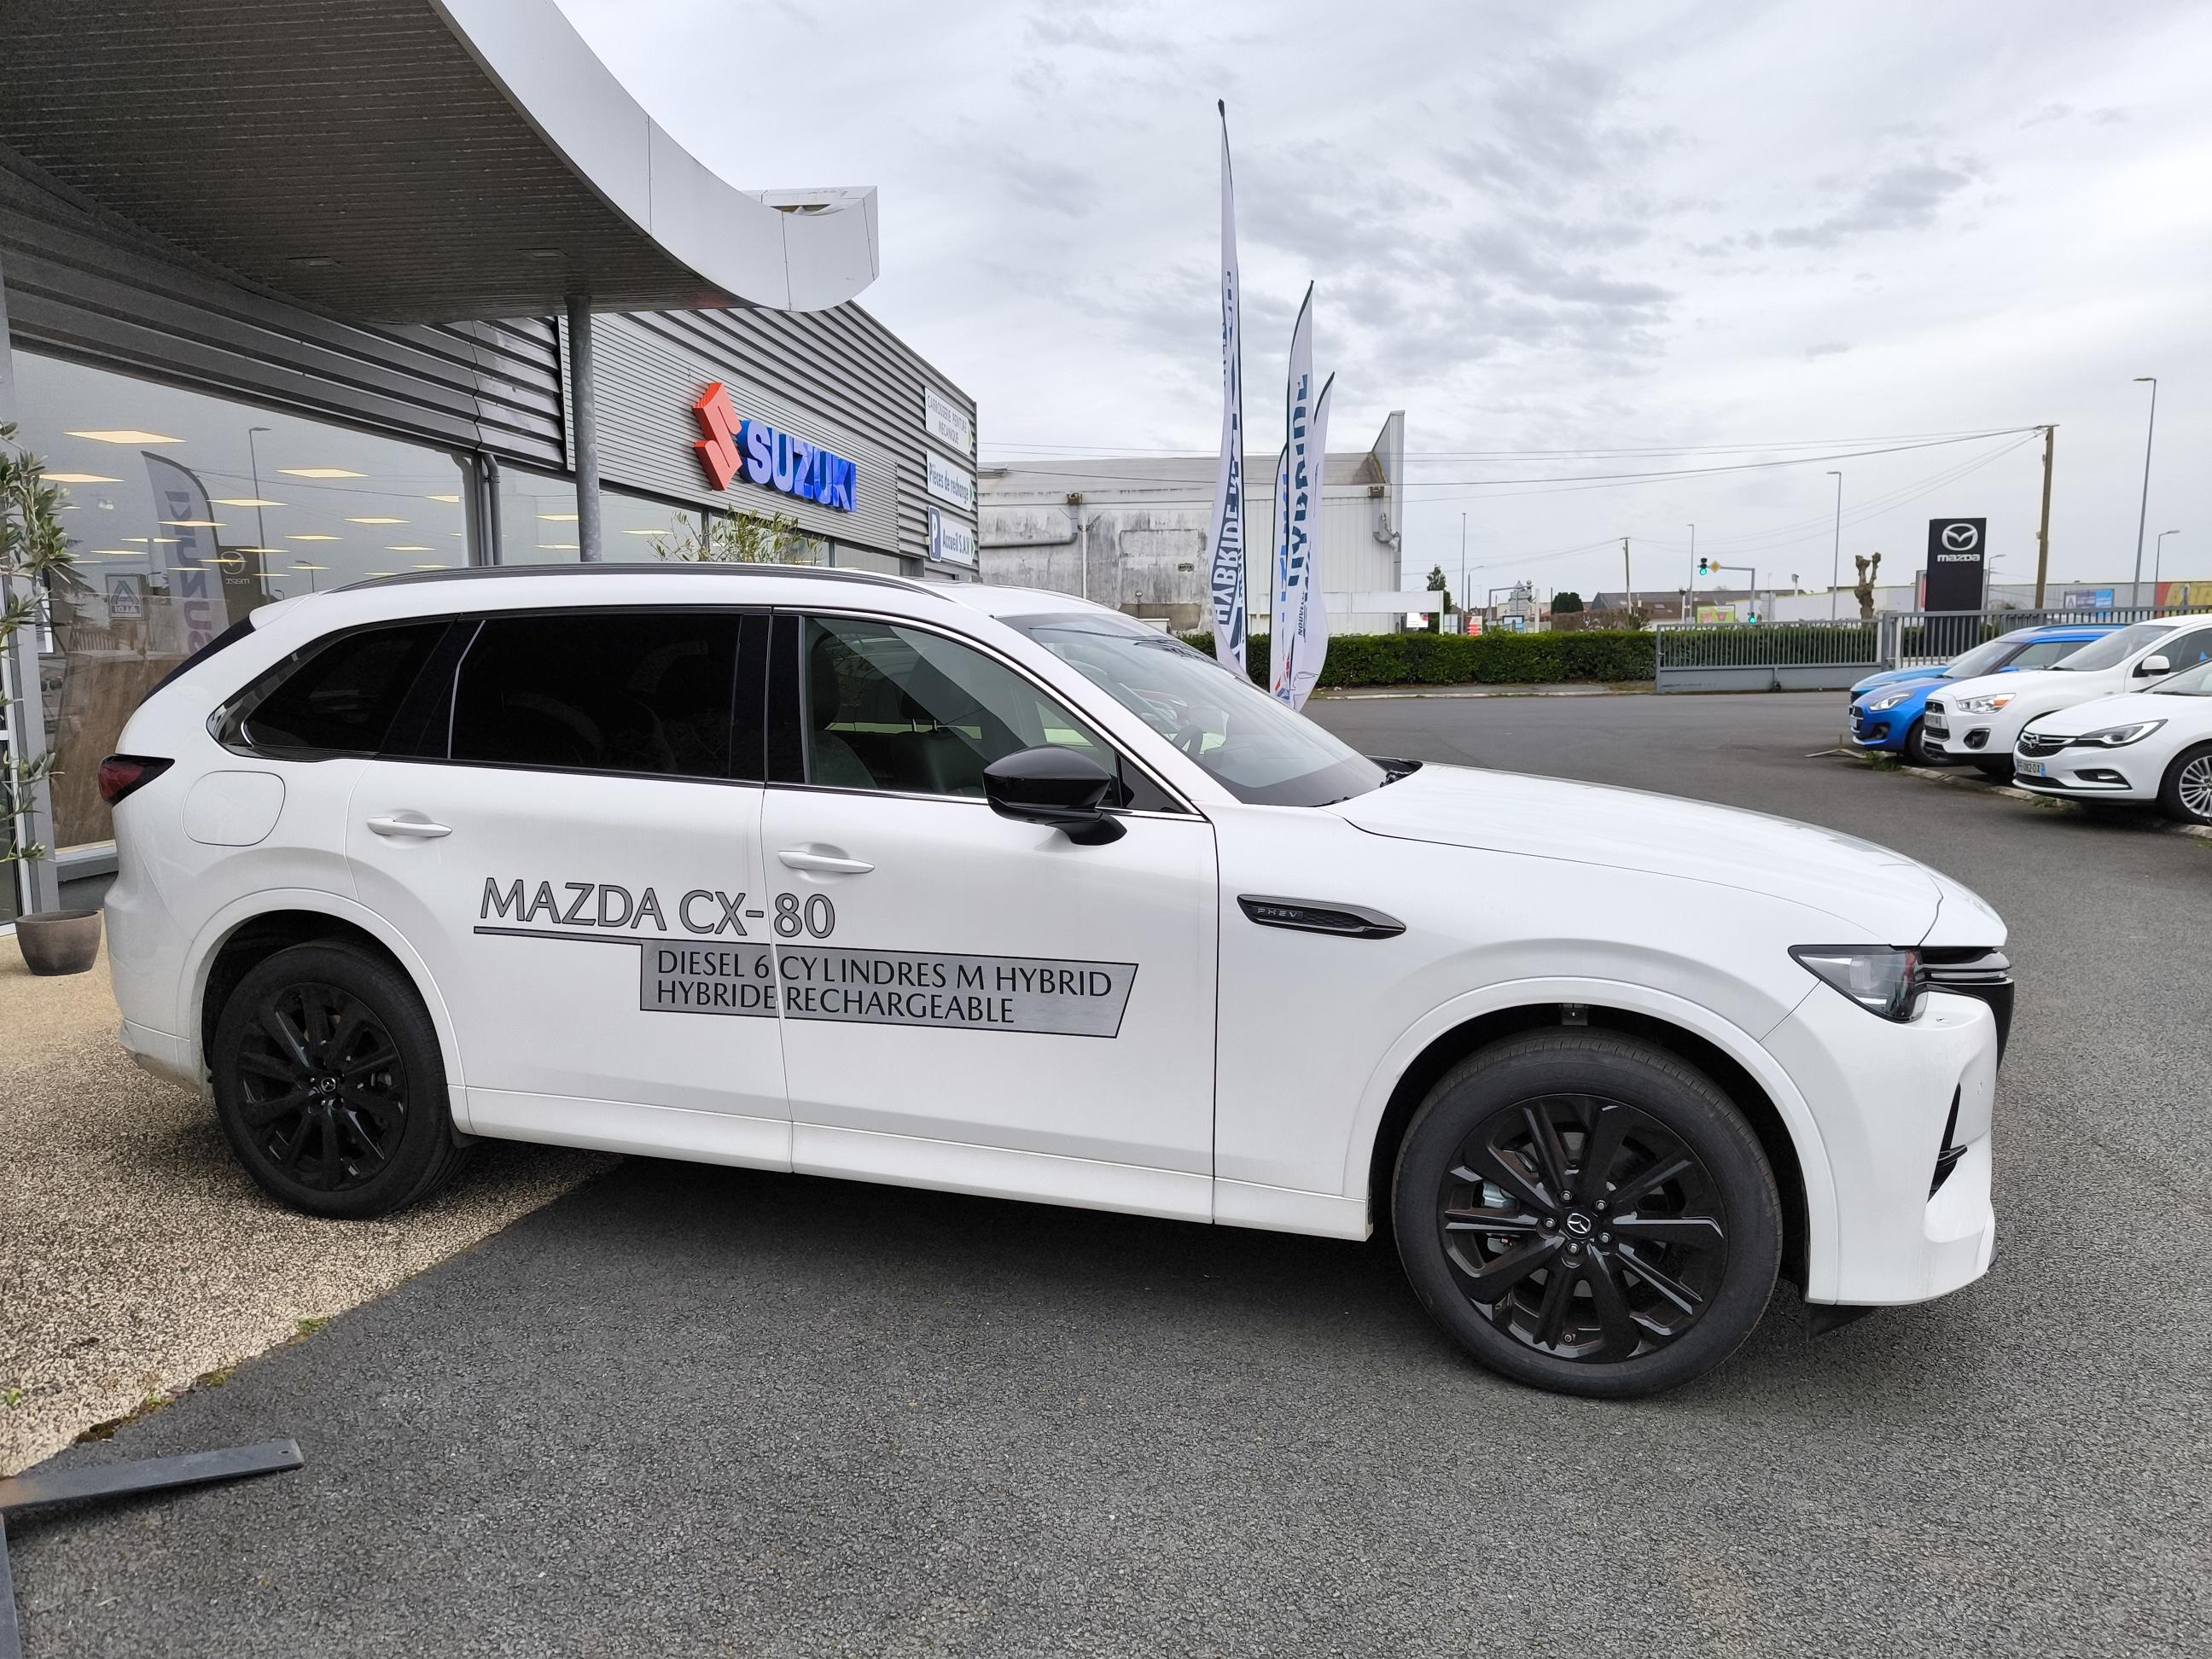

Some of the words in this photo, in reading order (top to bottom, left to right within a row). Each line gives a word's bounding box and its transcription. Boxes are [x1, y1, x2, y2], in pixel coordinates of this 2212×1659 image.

[927, 394, 952, 422] CARROSSERIE
[744, 418, 858, 513] SUZUKI
[928, 462, 944, 489] Pièces
[944, 470, 950, 492] de
[950, 475, 969, 504] rechange
[931, 513, 938, 554] P
[942, 528, 958, 551] Accueil
[1936, 553, 1981, 562] mazda
[480, 876, 667, 931] MAZDA
[678, 889, 836, 939] CX-80
[1256, 907, 1300, 917] PHEV
[657, 950, 745, 977] DIESEL
[754, 954, 770, 979] 6
[780, 955, 946, 988] CYLINDRES
[956, 963, 985, 990] M
[996, 966, 1112, 997] HYBRID
[657, 980, 776, 1009] HYBRIDE
[787, 987, 1015, 1023] RECHARGEABLE
